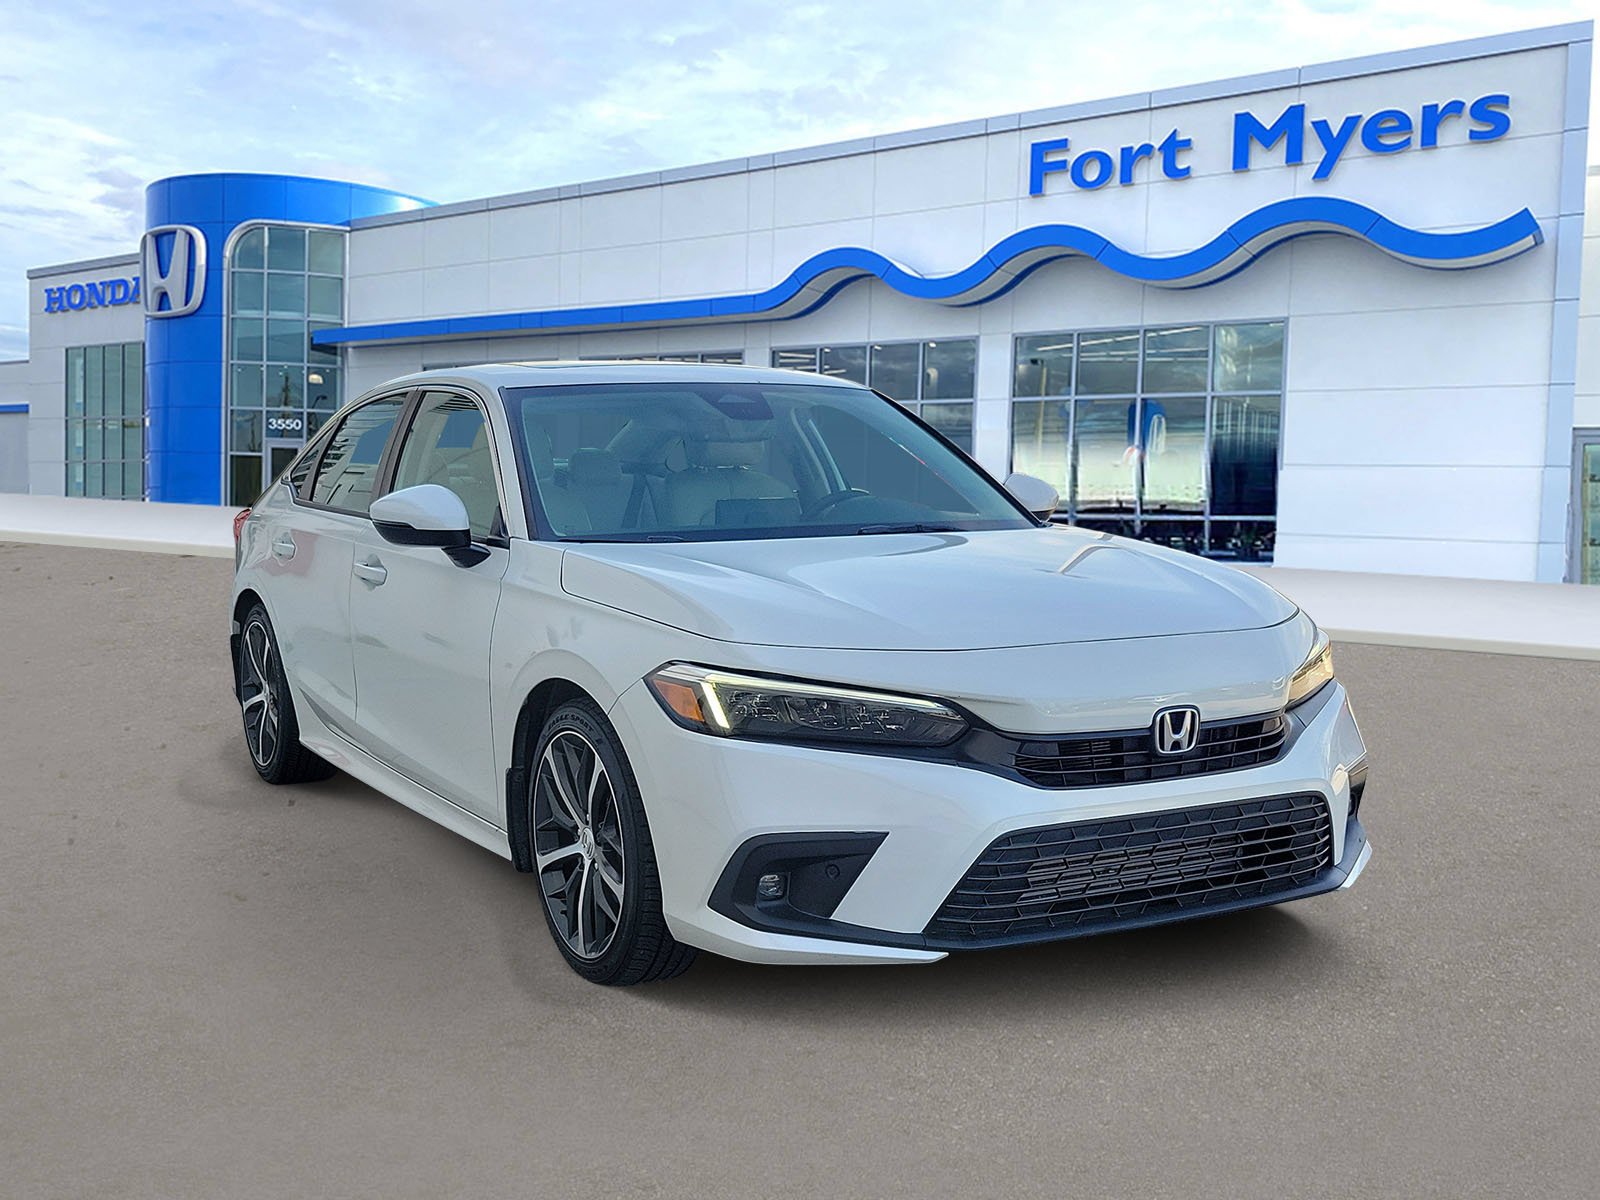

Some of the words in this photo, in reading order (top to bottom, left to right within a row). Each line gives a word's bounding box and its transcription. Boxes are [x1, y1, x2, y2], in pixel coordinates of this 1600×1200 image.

[1029, 128, 1193, 197] Fort
[1232, 93, 1511, 181] Myers
[268, 418, 302, 430] 3550
